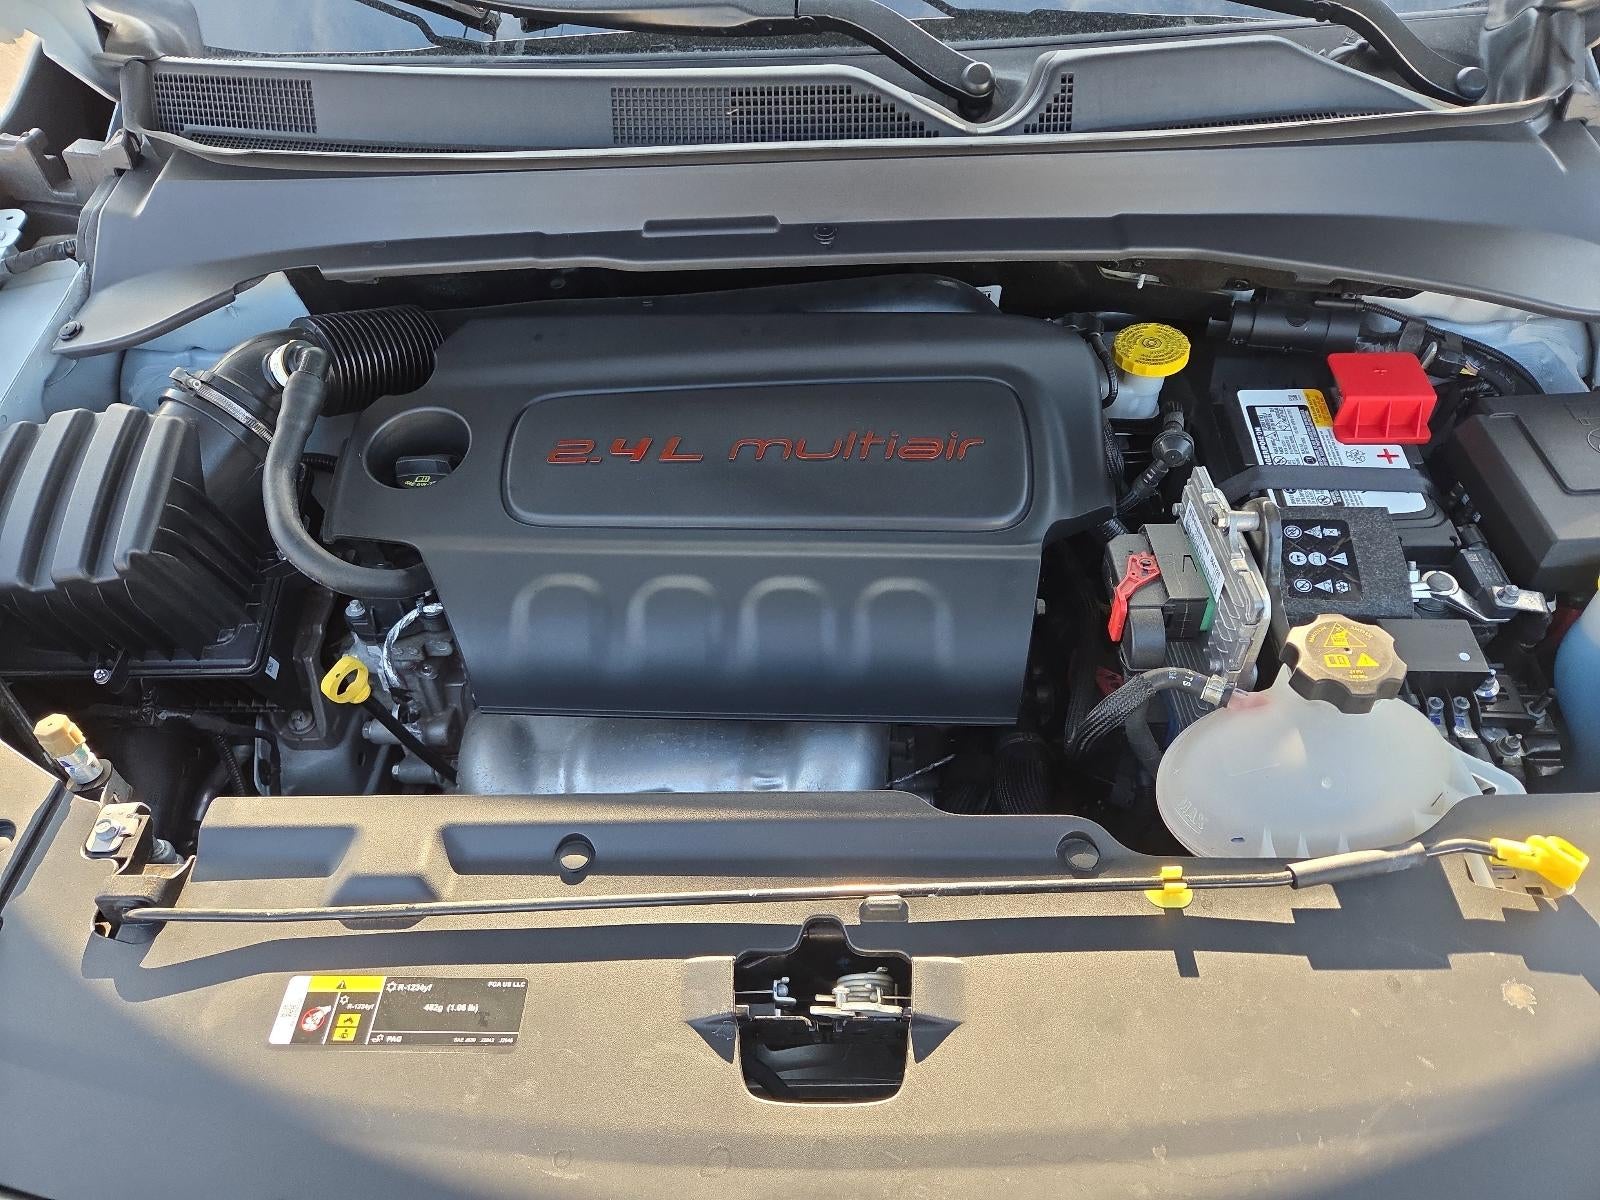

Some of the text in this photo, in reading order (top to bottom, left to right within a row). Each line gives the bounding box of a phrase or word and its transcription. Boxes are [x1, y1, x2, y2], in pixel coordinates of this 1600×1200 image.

[728, 430, 985, 462] multiair
[397, 983, 433, 993] R-1234yf
[386, 1035, 403, 1043] PAG
